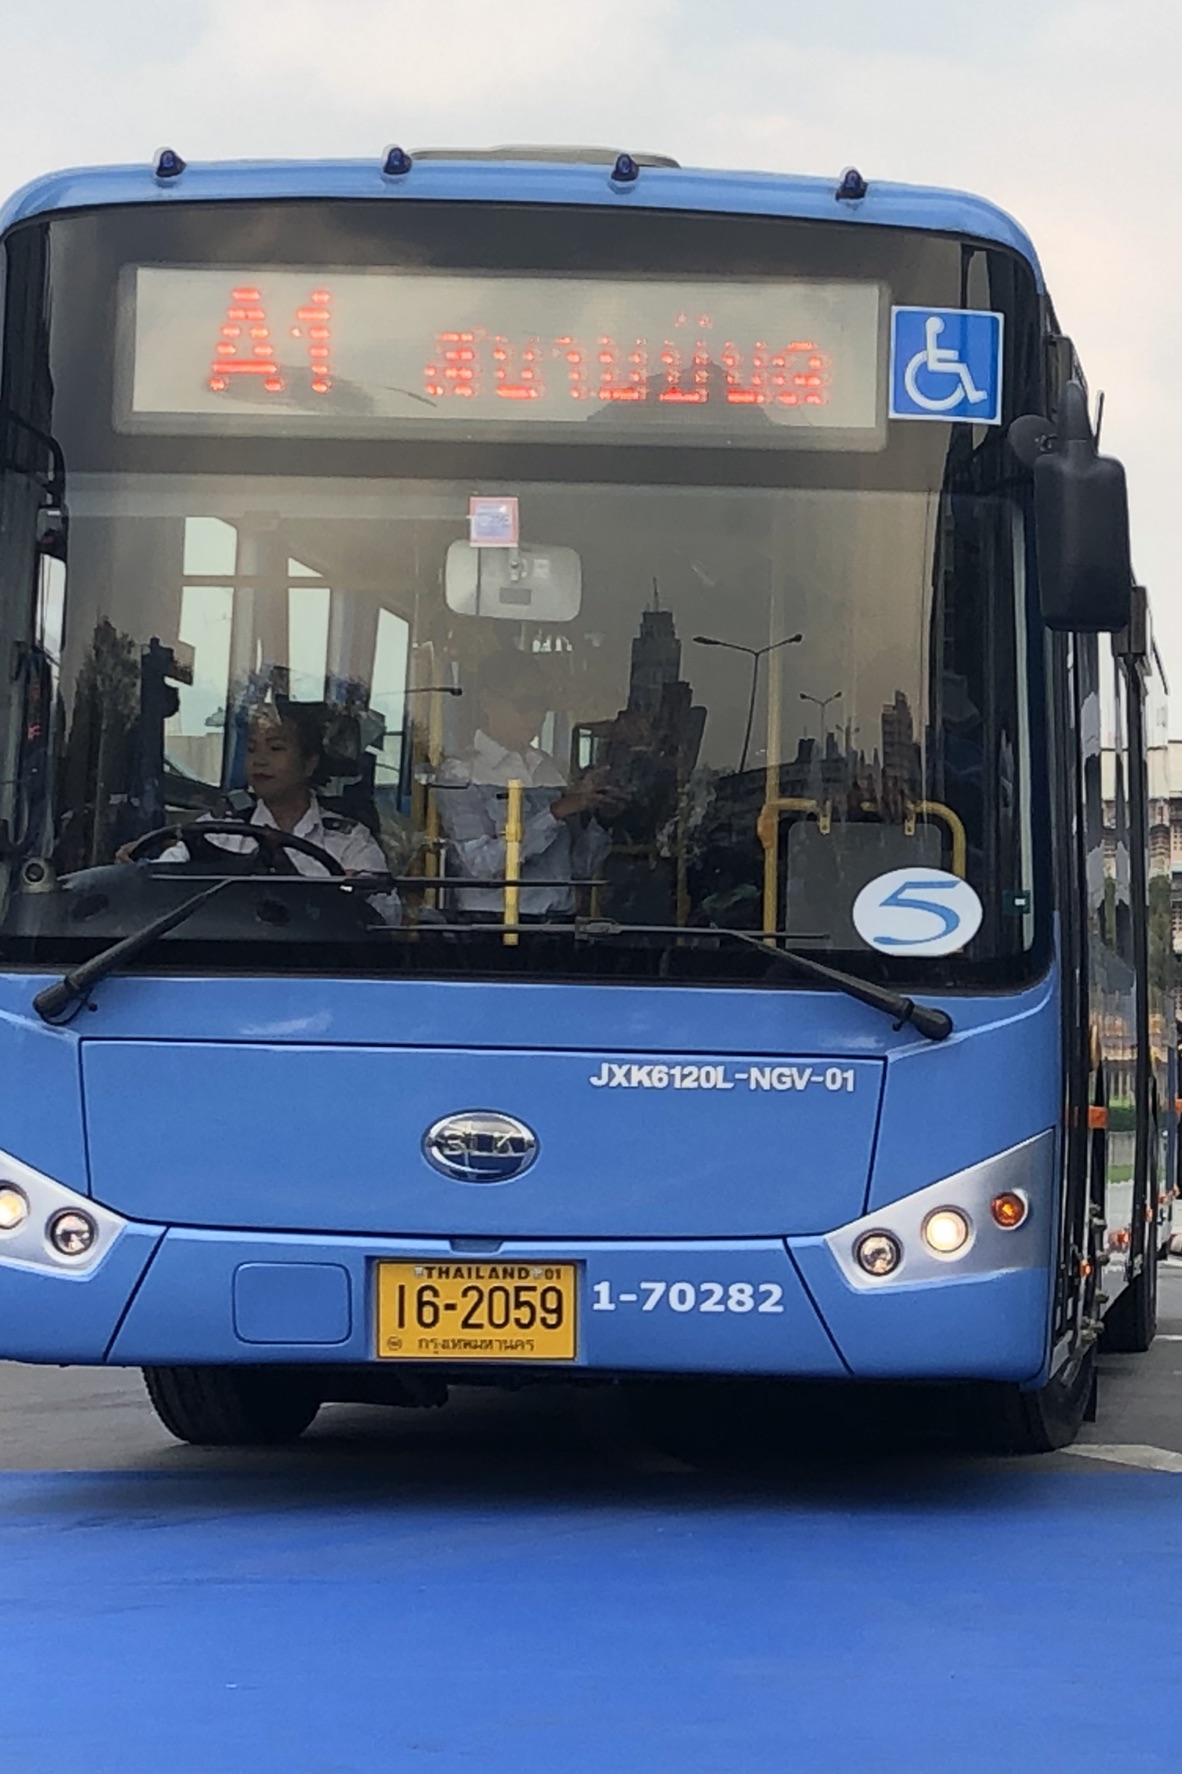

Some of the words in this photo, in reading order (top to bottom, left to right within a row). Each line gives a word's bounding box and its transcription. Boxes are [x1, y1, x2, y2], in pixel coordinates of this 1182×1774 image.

[209, 287, 331, 394] A1
[873, 880, 961, 946] 5
[589, 1062, 855, 1092] JXK6120L-NGV-01
[425, 1266, 530, 1280] THAILAND
[544, 1268, 561, 1280] 01
[398, 1284, 563, 1329] 16-2059
[592, 1281, 784, 1313] 1-70282
